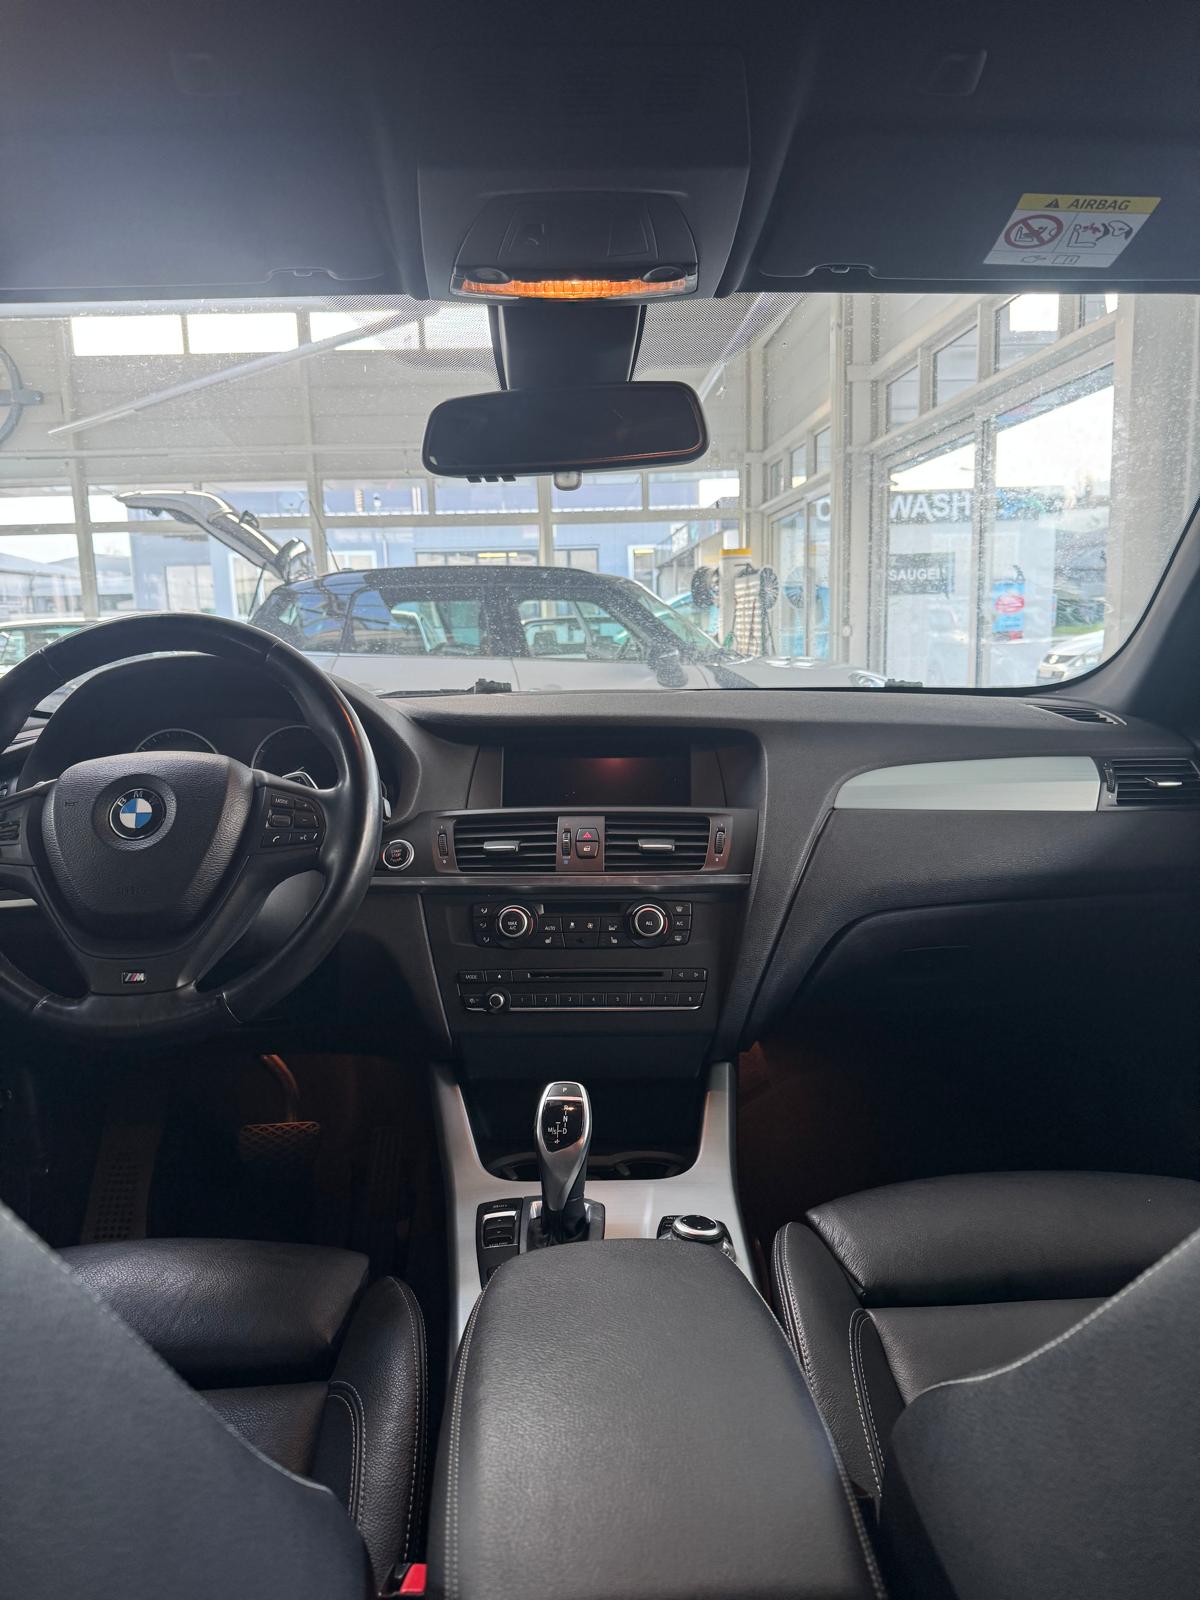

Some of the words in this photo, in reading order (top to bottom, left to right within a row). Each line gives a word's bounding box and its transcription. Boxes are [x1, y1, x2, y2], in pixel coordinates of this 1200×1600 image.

[1067, 198, 1131, 211] AIRBAG
[889, 492, 971, 521] WASH
[562, 1127, 568, 1135] D
